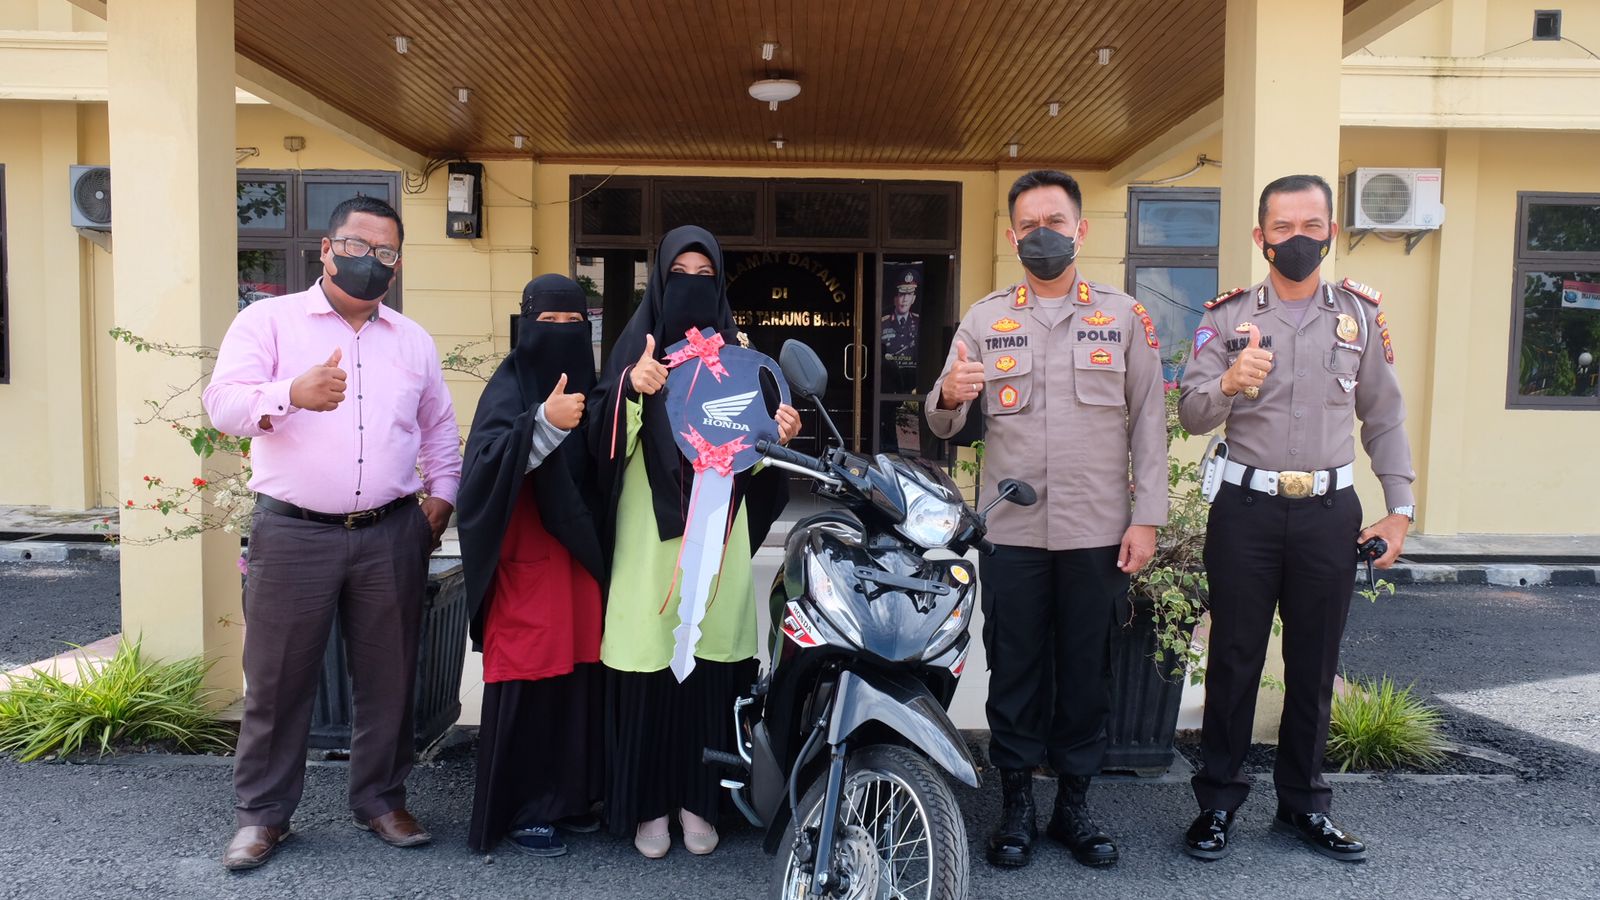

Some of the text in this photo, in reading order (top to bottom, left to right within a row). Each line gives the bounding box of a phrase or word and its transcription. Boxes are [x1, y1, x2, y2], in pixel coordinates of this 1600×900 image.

[725, 252, 846, 303] LAMAT DATANG
[771, 287, 788, 299] DI
[732, 310, 850, 327] RES TANJUNG BALAI
[985, 335, 1028, 350] TRIYADI
[1077, 330, 1121, 343] POLRI
[702, 418, 750, 431] HONDA
[793, 605, 812, 634] HONDA
